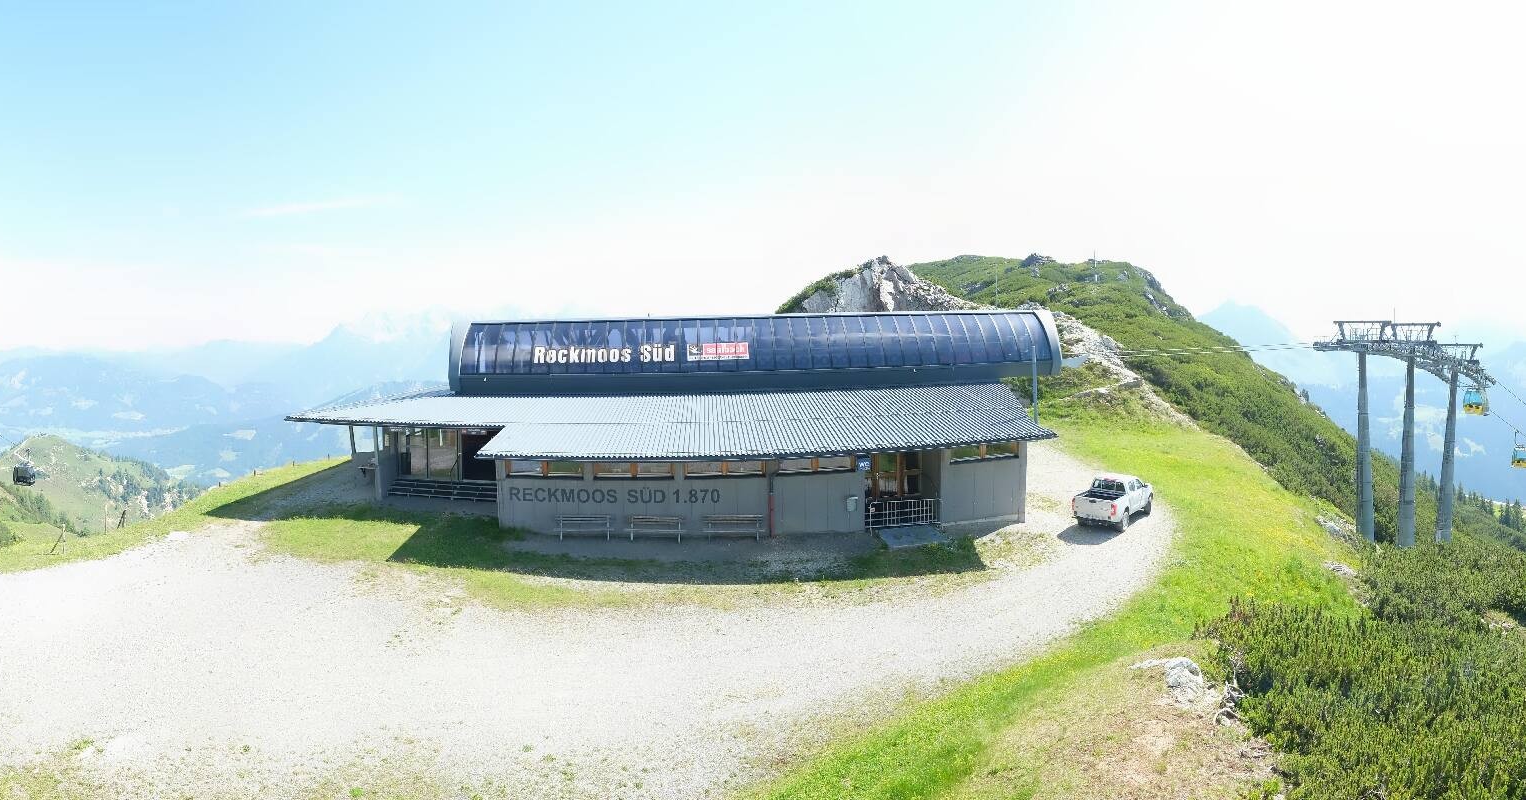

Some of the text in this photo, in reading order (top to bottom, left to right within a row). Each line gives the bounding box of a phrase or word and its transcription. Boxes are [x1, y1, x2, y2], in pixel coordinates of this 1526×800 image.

[533, 342, 675, 364] Reckmoos Süd
[509, 486, 721, 504] RECKMOOS SÜD 1.870
